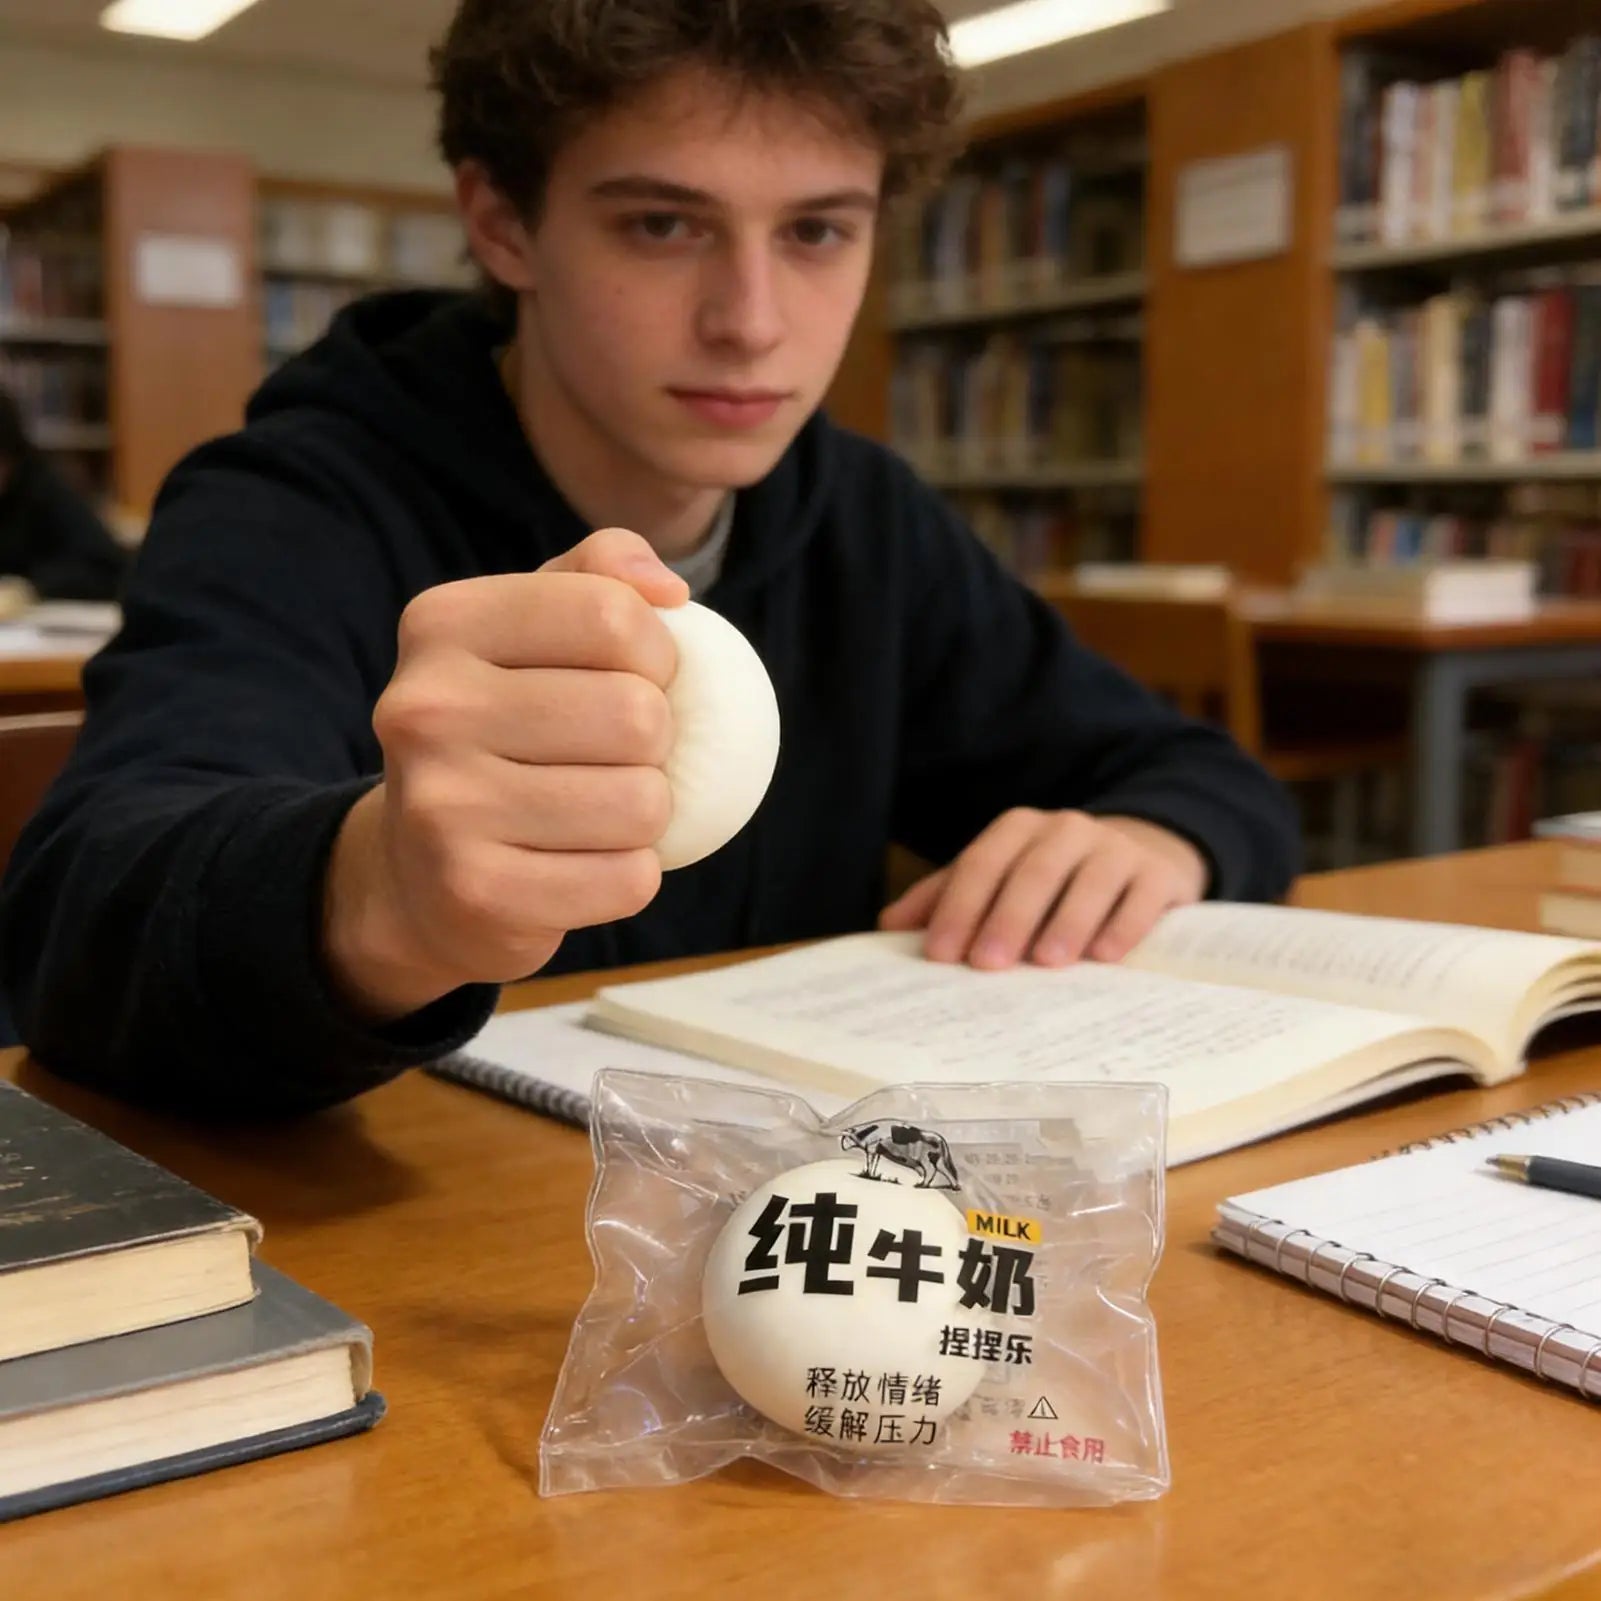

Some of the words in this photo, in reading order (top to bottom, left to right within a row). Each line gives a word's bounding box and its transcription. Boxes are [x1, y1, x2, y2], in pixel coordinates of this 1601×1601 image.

[975, 1213, 1032, 1241] MILK
[738, 1192, 1036, 1317] 纯牛奶
[939, 1325, 1033, 1365] 捏捏乐
[806, 1367, 942, 1407] 释放情绪
[803, 1405, 937, 1446] 缓解压力
[1010, 1430, 1105, 1464] 禁止食用
